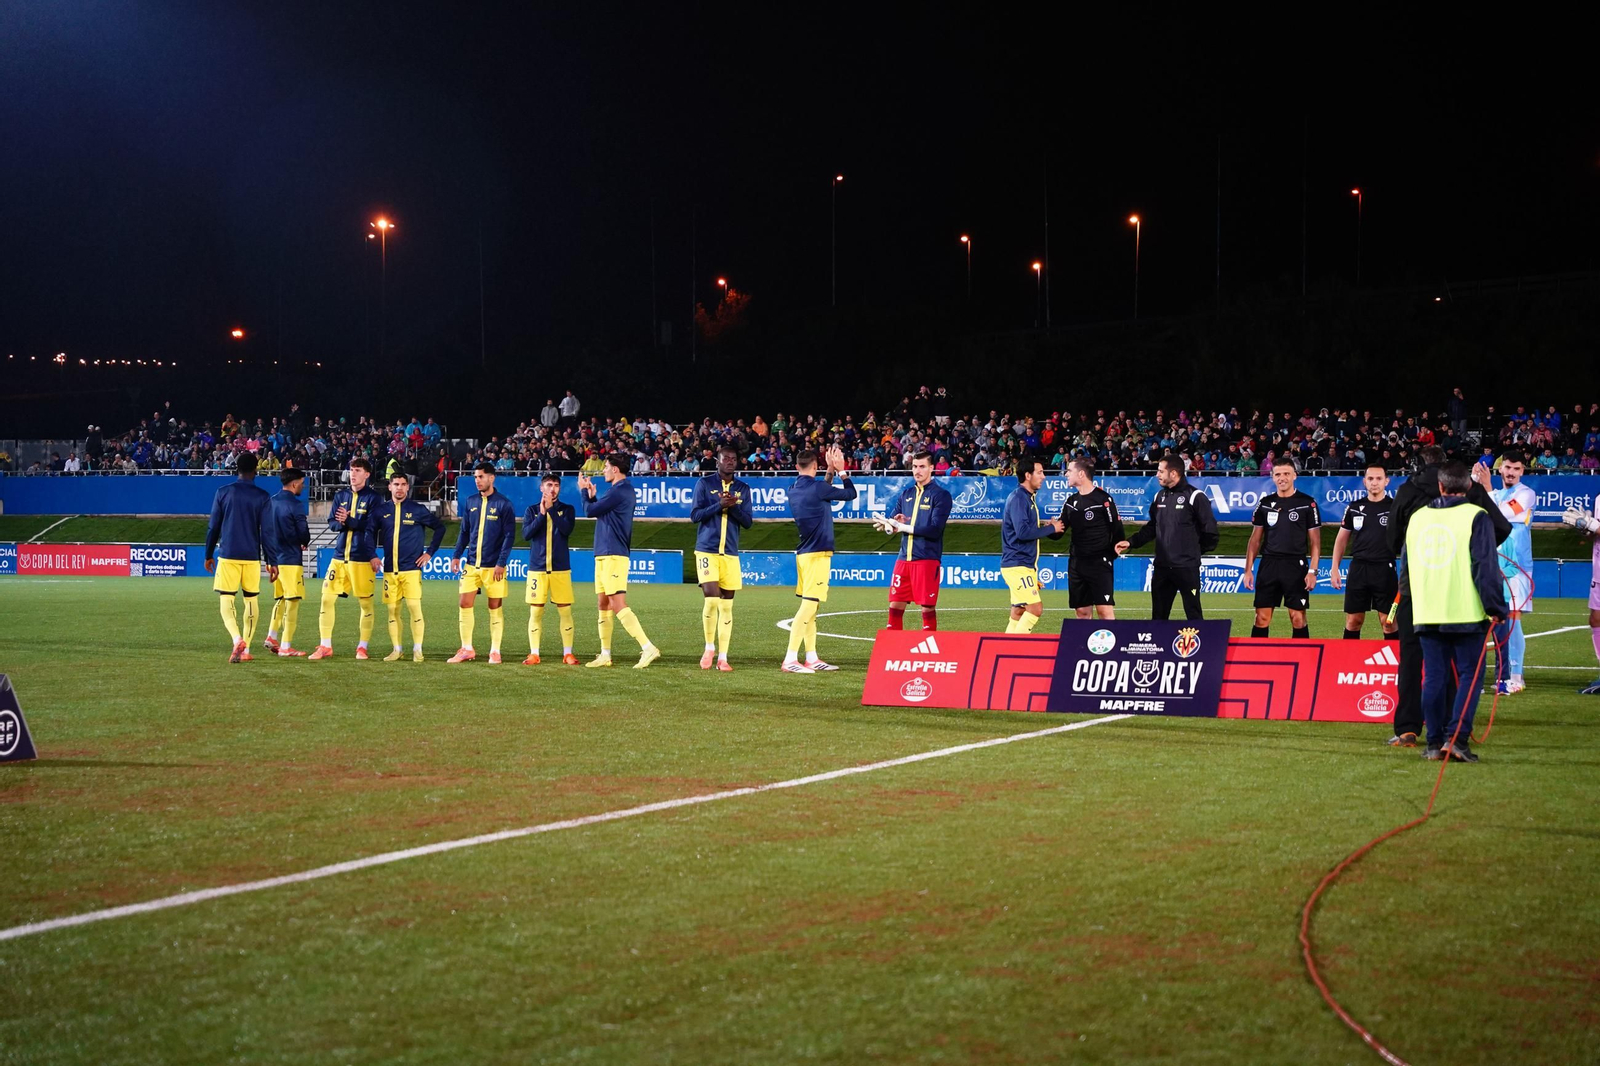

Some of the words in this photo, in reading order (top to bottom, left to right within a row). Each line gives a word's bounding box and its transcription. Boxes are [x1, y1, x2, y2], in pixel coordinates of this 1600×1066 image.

[1105, 486, 1145, 496] Tecnología
[1326, 485, 1367, 502] GÓME
[766, 505, 785, 513] parts
[130, 549, 187, 561] RECOSUR
[32, 554, 53, 569] COPA
[55, 554, 69, 569] DEL
[72, 554, 86, 569] REY
[91, 558, 128, 566] MAPFRE
[947, 566, 1000, 585] Keyter
[1199, 566, 1240, 577] Pinturas
[531, 579, 537, 590] 3
[891, 574, 901, 588] 13
[1021, 575, 1034, 589] 10
[1138, 633, 1152, 642] VS
[885, 660, 958, 673] MAPFRE
[1072, 659, 1130, 693] COPA
[1159, 661, 1203, 694] REY
[1100, 700, 1165, 712] MAPFRE
